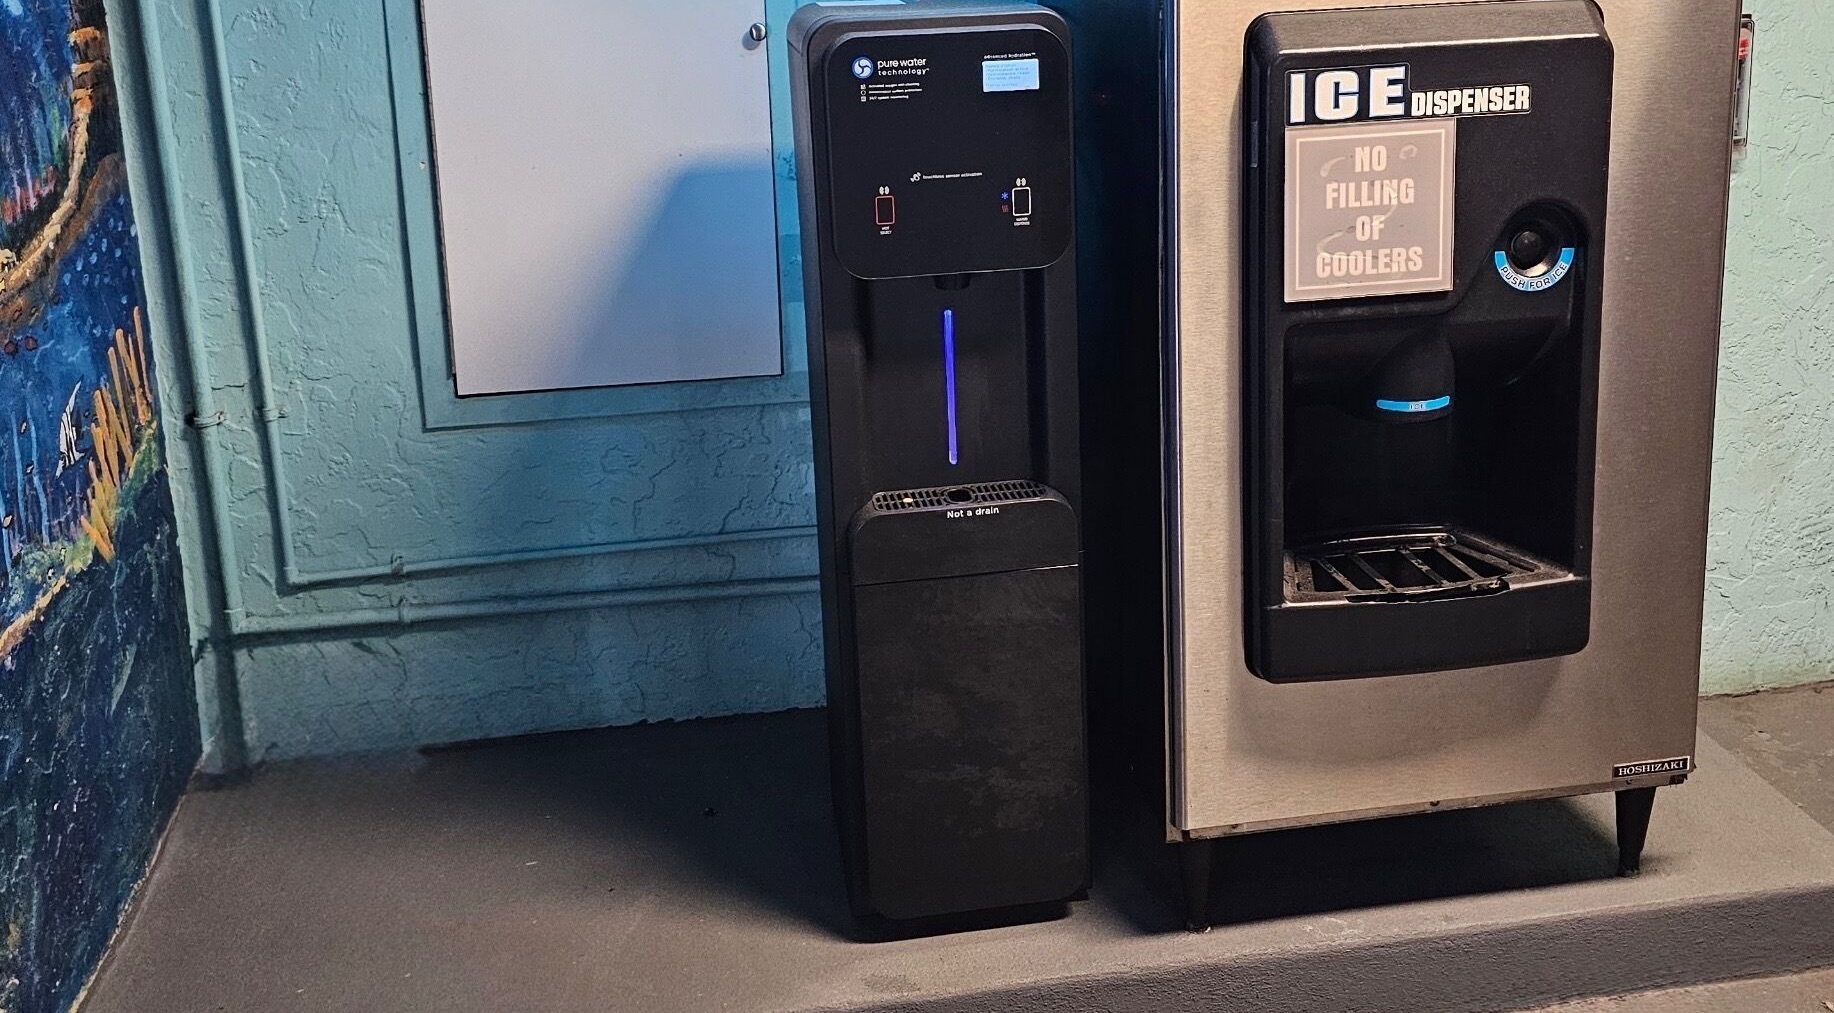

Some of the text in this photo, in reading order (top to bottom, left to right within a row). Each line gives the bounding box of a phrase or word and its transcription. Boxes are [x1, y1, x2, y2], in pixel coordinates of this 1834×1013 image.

[877, 58, 927, 70] pure water
[1288, 65, 1530, 124] ICE DISPENSER
[1354, 144, 1388, 173] NO
[1325, 177, 1415, 210] FILLING
[1354, 213, 1386, 242] OF
[1315, 246, 1424, 279] COOLERS
[1500, 263, 1569, 289] PUSH FOR ICE
[946, 506, 1000, 519] Not a drain
[1618, 760, 1684, 776] HOSHIZAKI
